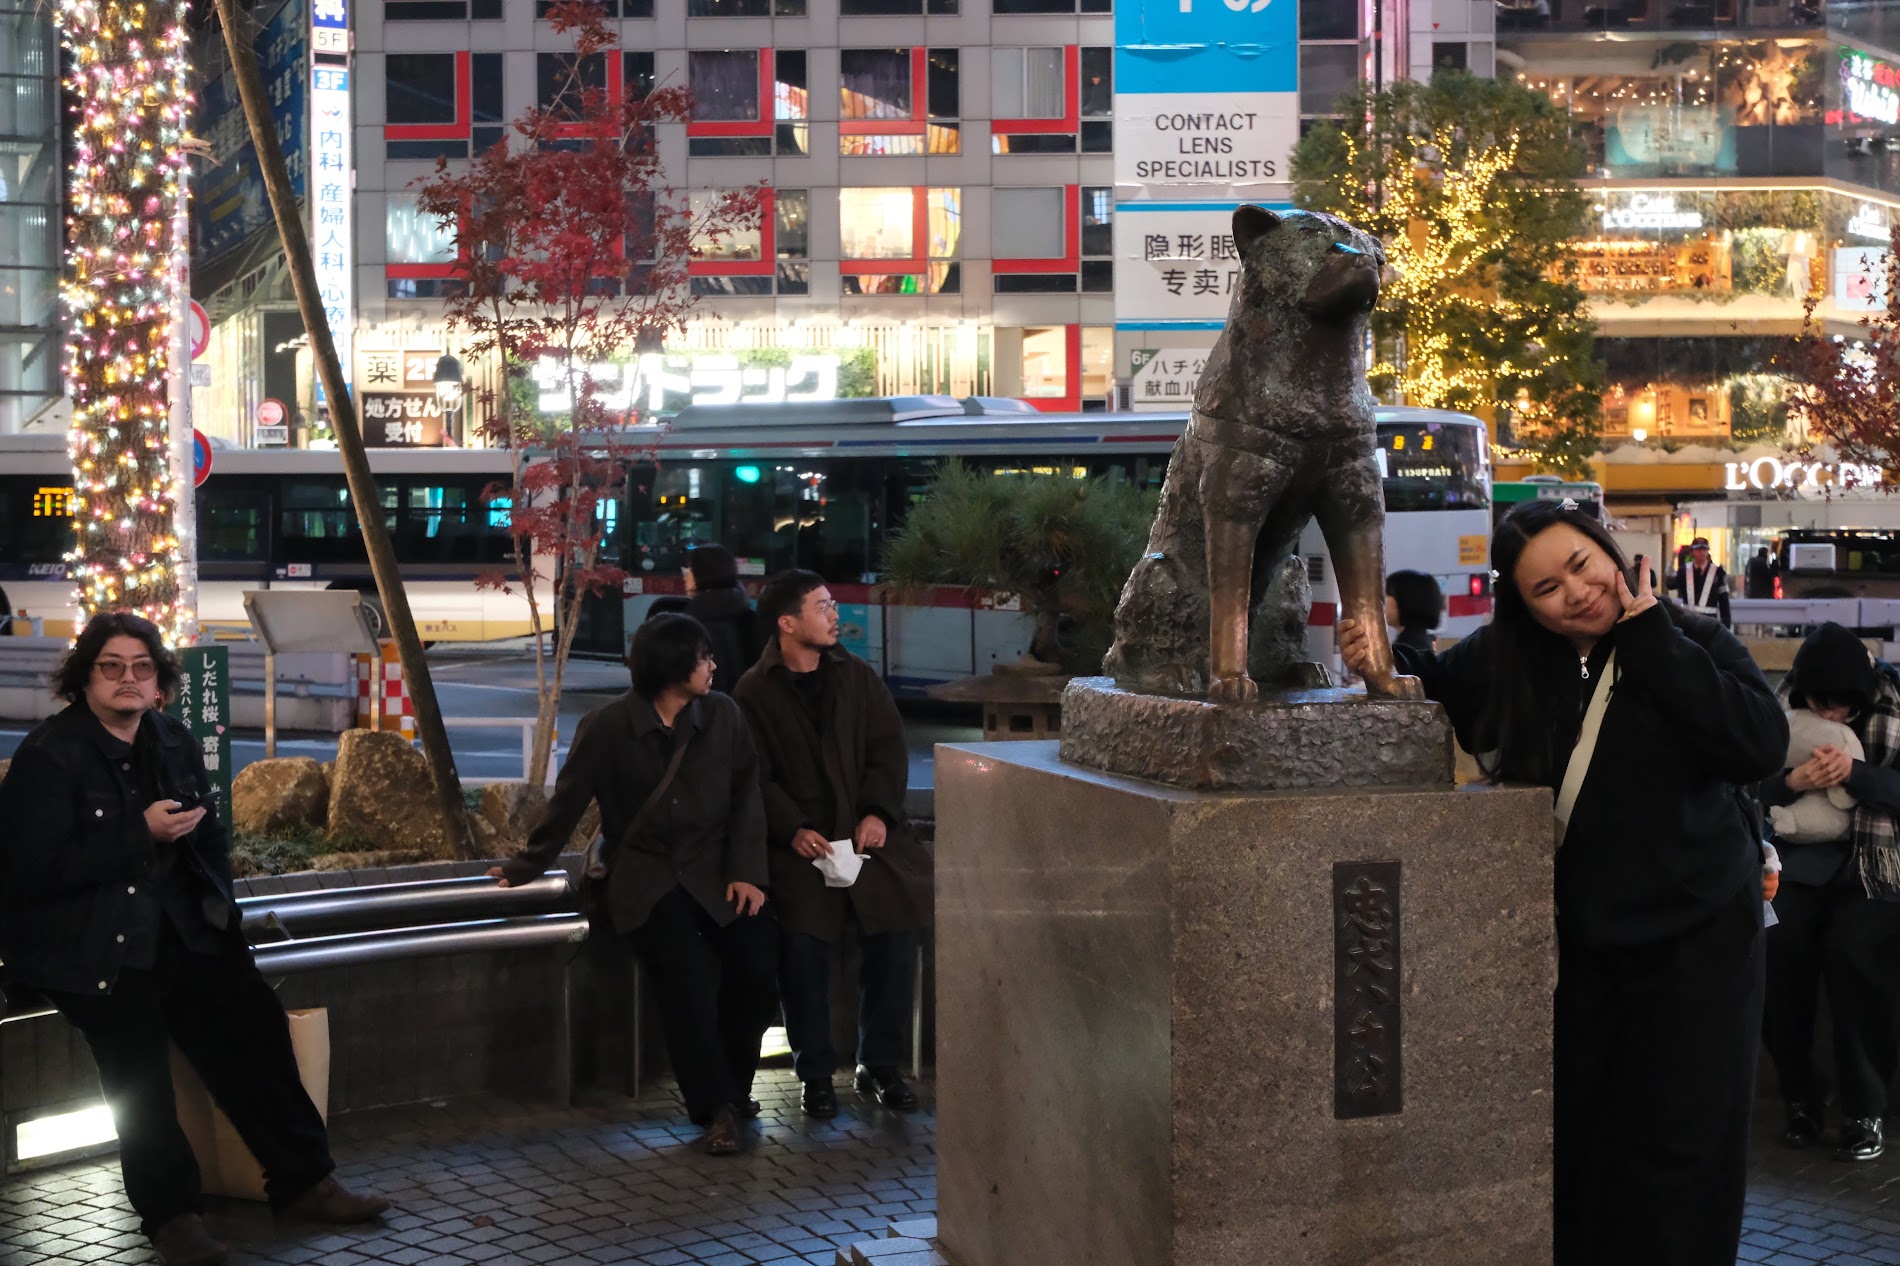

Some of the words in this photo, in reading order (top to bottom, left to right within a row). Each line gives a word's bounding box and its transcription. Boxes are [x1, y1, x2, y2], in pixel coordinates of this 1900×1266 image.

[317, 71, 344, 90] 3F
[1155, 113, 1257, 131] CONTACT
[319, 129, 343, 172] 内科
[1179, 137, 1233, 154] LENS
[1136, 160, 1276, 178] SPECIALISTS
[320, 182, 344, 271] 産婦人科
[1144, 234, 1238, 262] 隐形眼
[367, 355, 397, 383] 薬
[1131, 352, 1150, 366] 6F
[365, 397, 441, 418] 処方せん
[385, 421, 423, 443] 受付
[28, 562, 66, 575] KEIO
[202, 652, 219, 723] しだれ桜
[203, 735, 220, 771] 寄贈
